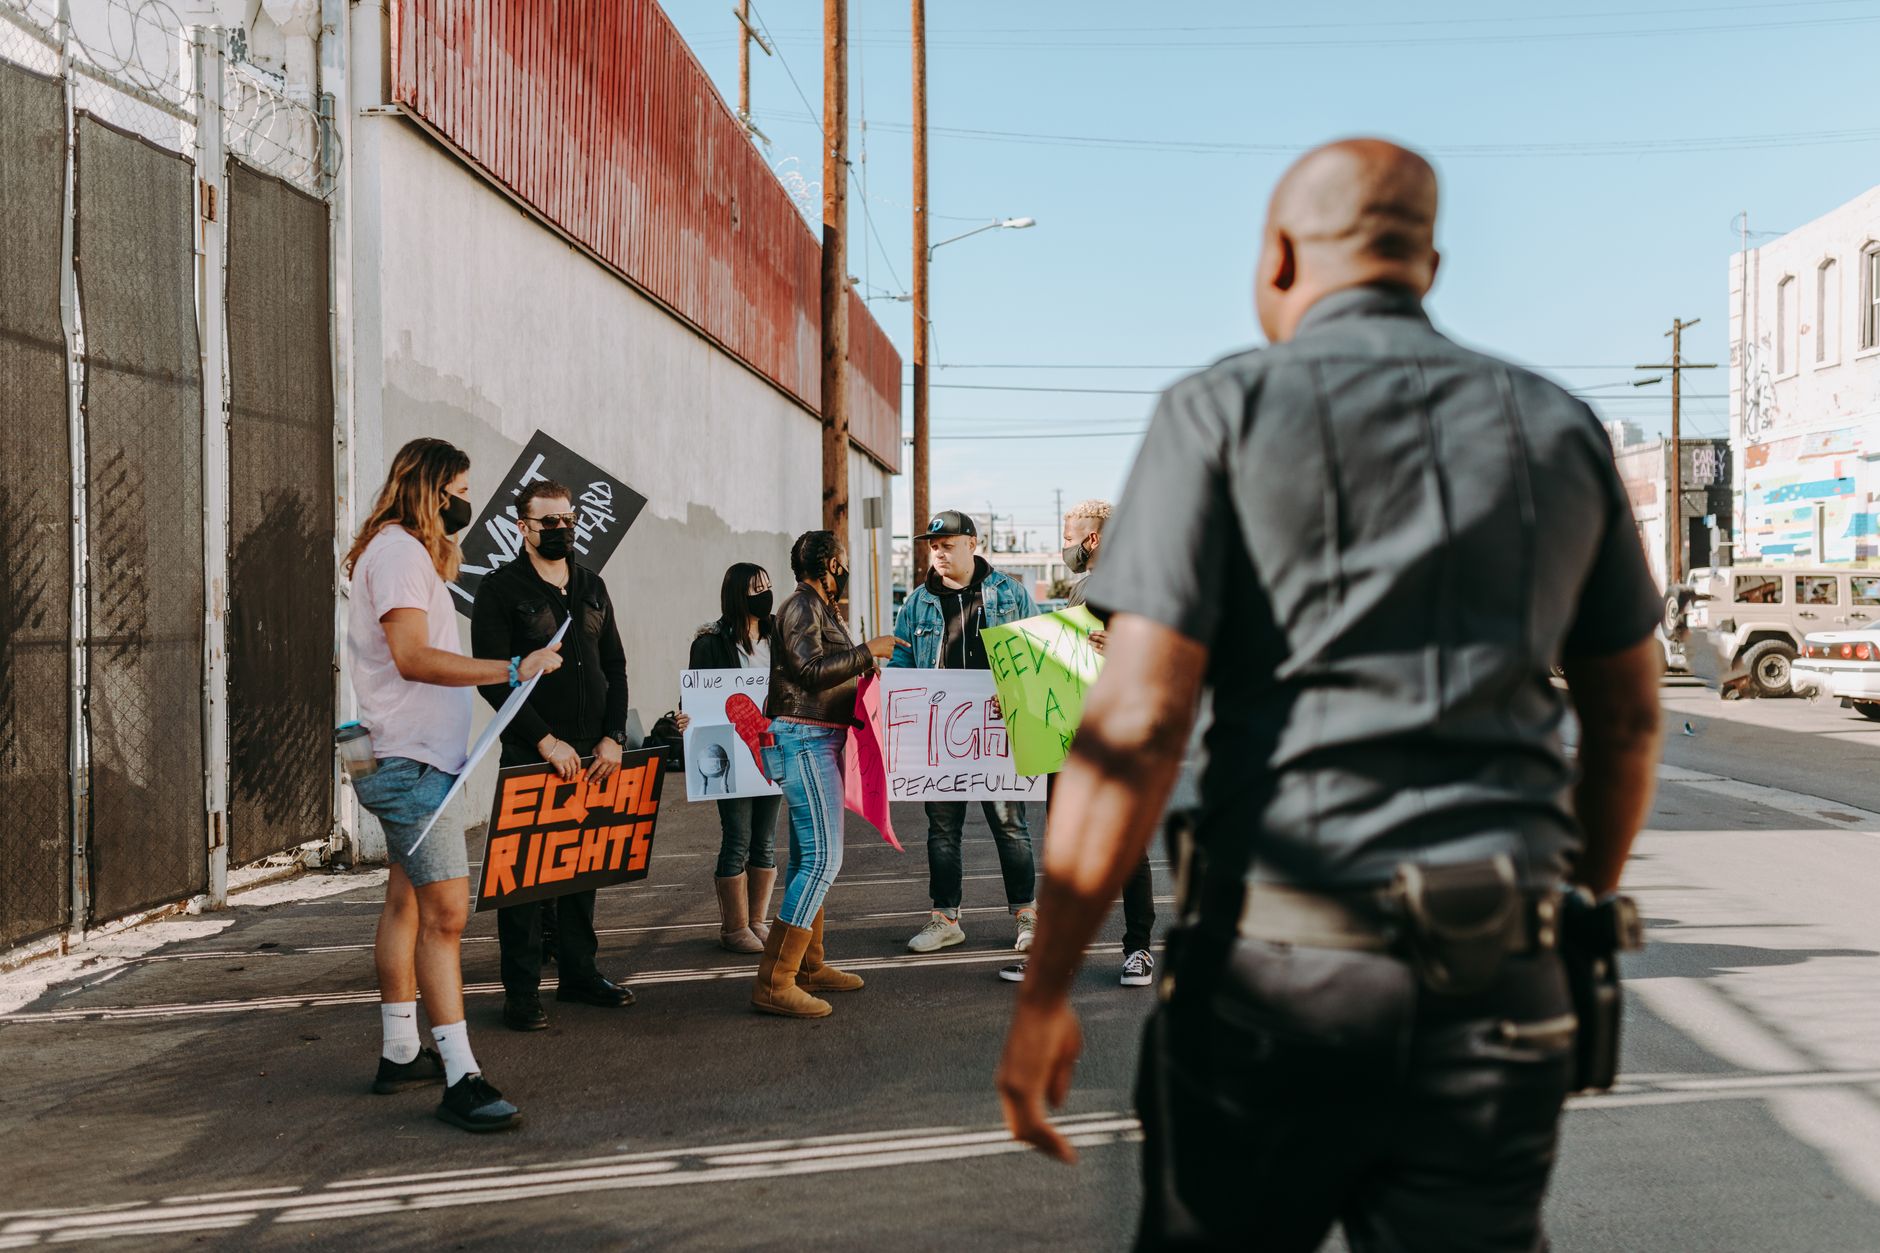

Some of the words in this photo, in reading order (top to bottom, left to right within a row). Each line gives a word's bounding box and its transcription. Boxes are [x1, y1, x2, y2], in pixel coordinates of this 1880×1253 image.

[572, 481, 617, 556] HEARD
[682, 671, 699, 689] all
[703, 675, 722, 689] we
[497, 757, 660, 831] EQUAL
[892, 774, 1038, 797] PEACEFULLY
[483, 820, 653, 898] RIGHTS
